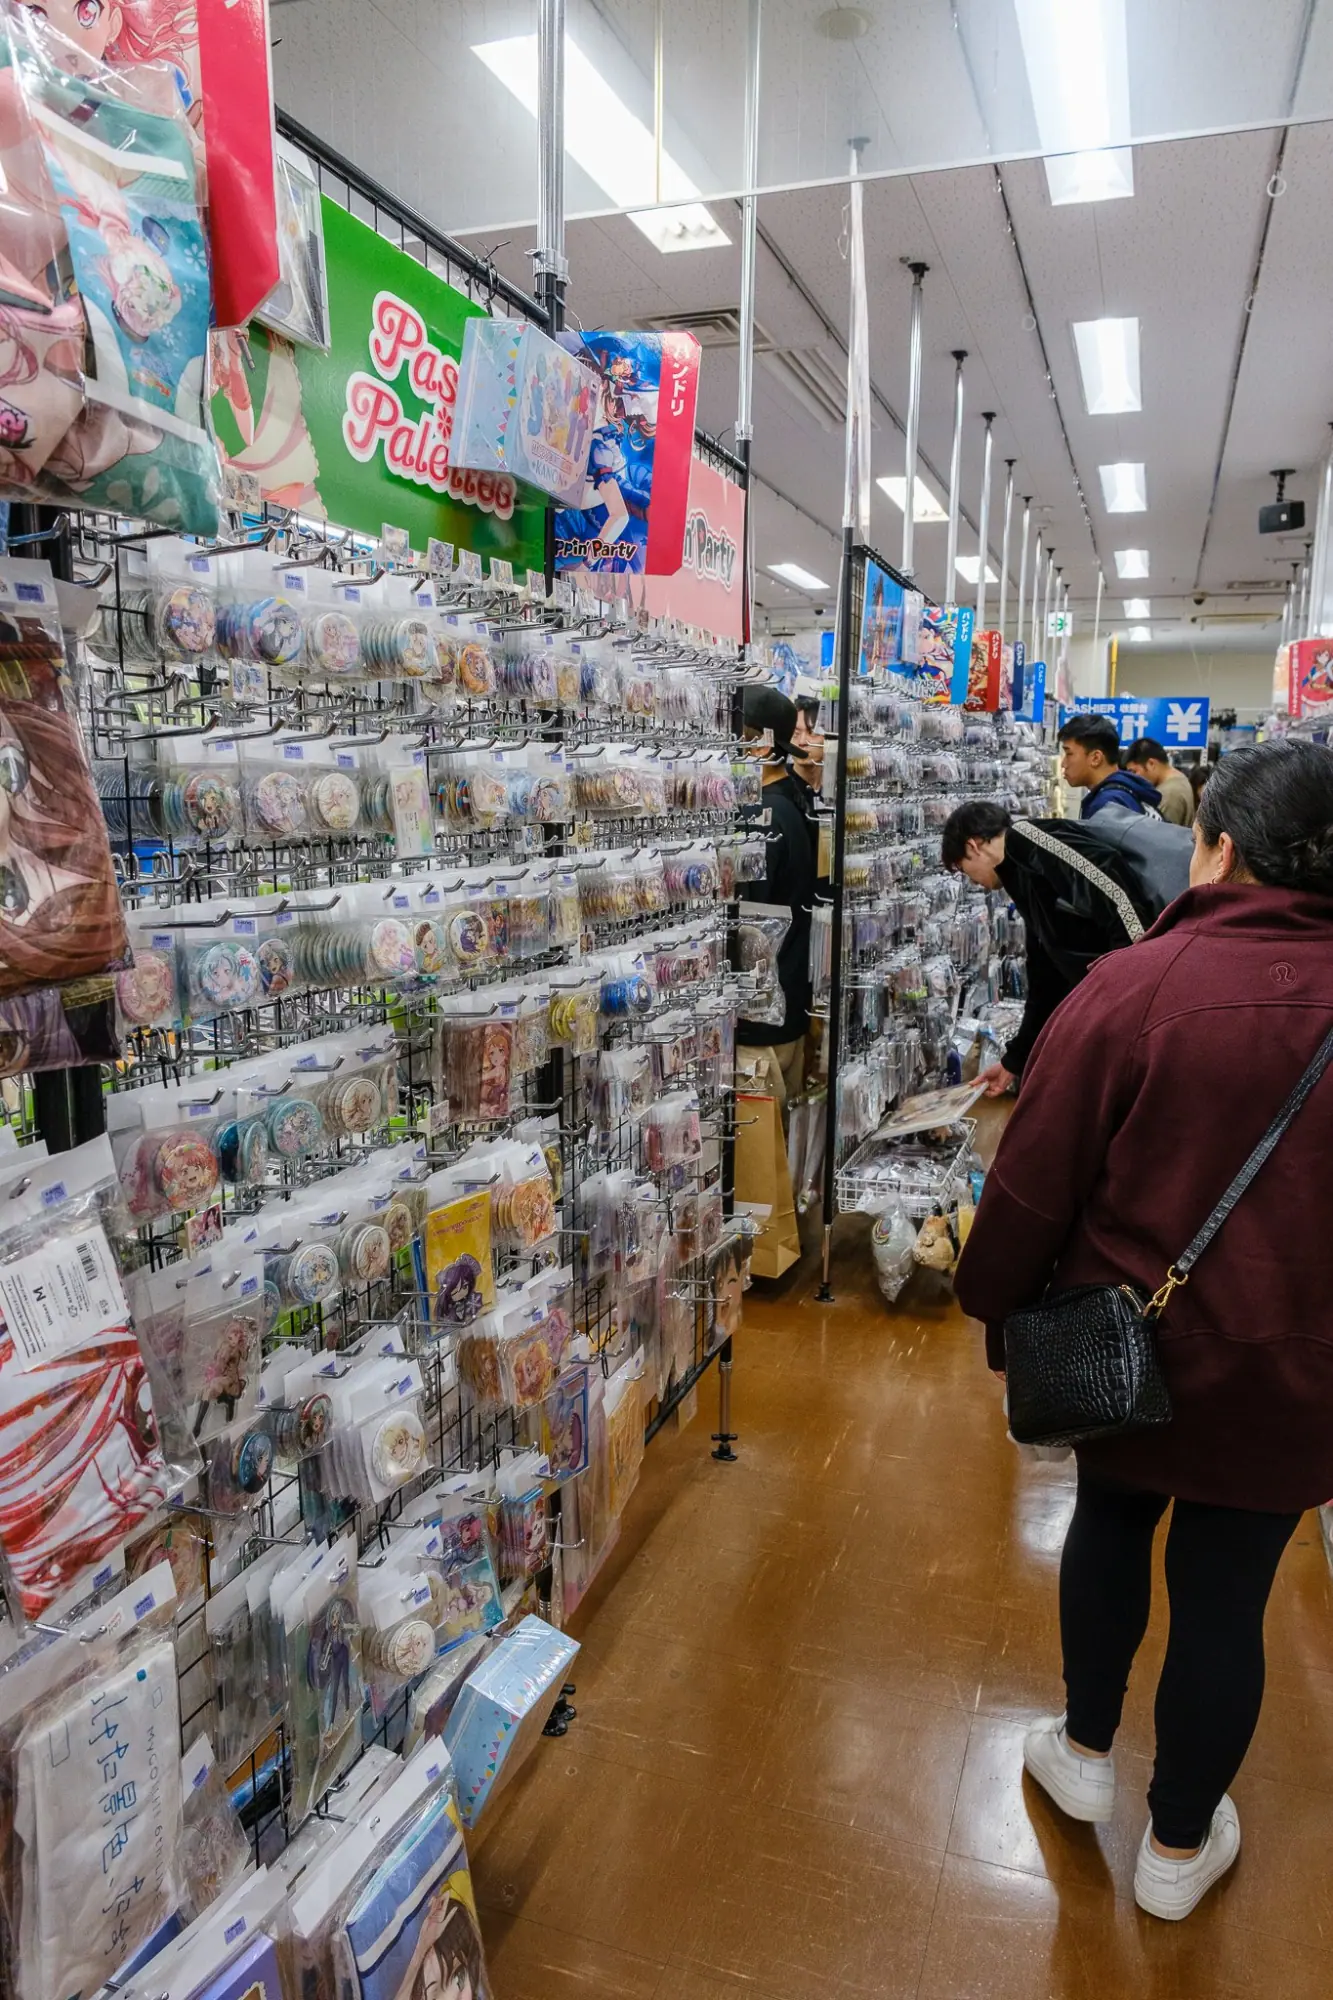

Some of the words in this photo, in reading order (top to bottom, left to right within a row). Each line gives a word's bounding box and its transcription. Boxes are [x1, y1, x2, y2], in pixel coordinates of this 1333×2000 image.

[372, 298, 459, 404] Pas
[592, 539, 637, 559] Party
[695, 516, 737, 583] Party
[1064, 703, 1116, 714] CASHIER
[1166, 703, 1202, 742] ¥
[32, 1286, 47, 1302] M
